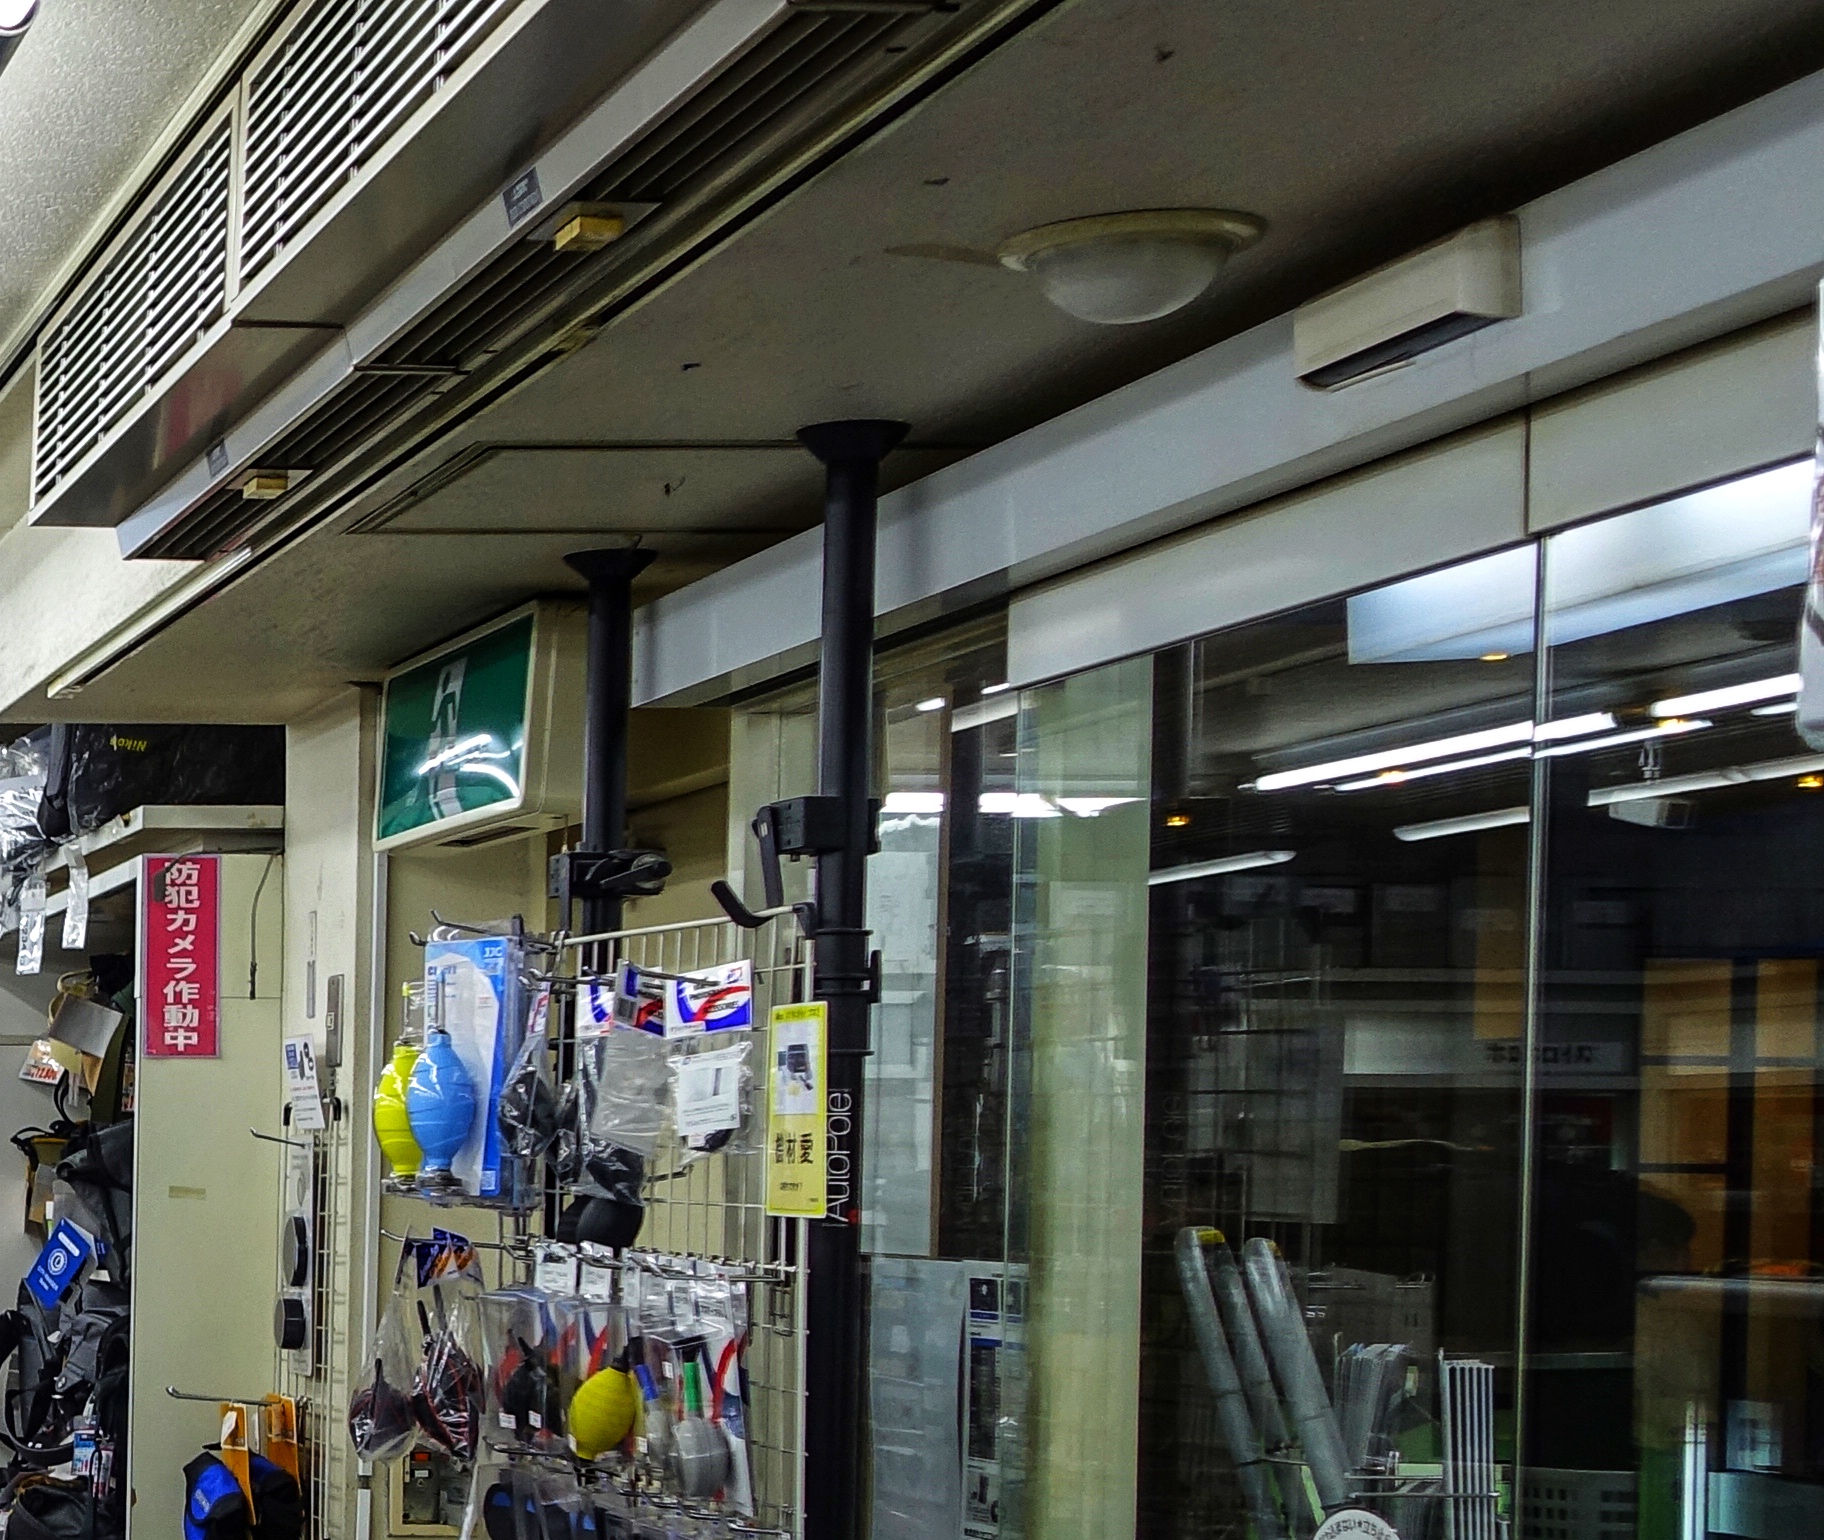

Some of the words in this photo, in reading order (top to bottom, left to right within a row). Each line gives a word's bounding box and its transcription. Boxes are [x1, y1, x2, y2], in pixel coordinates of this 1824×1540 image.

[161, 859, 202, 1053] 防犯カメラ作動中
